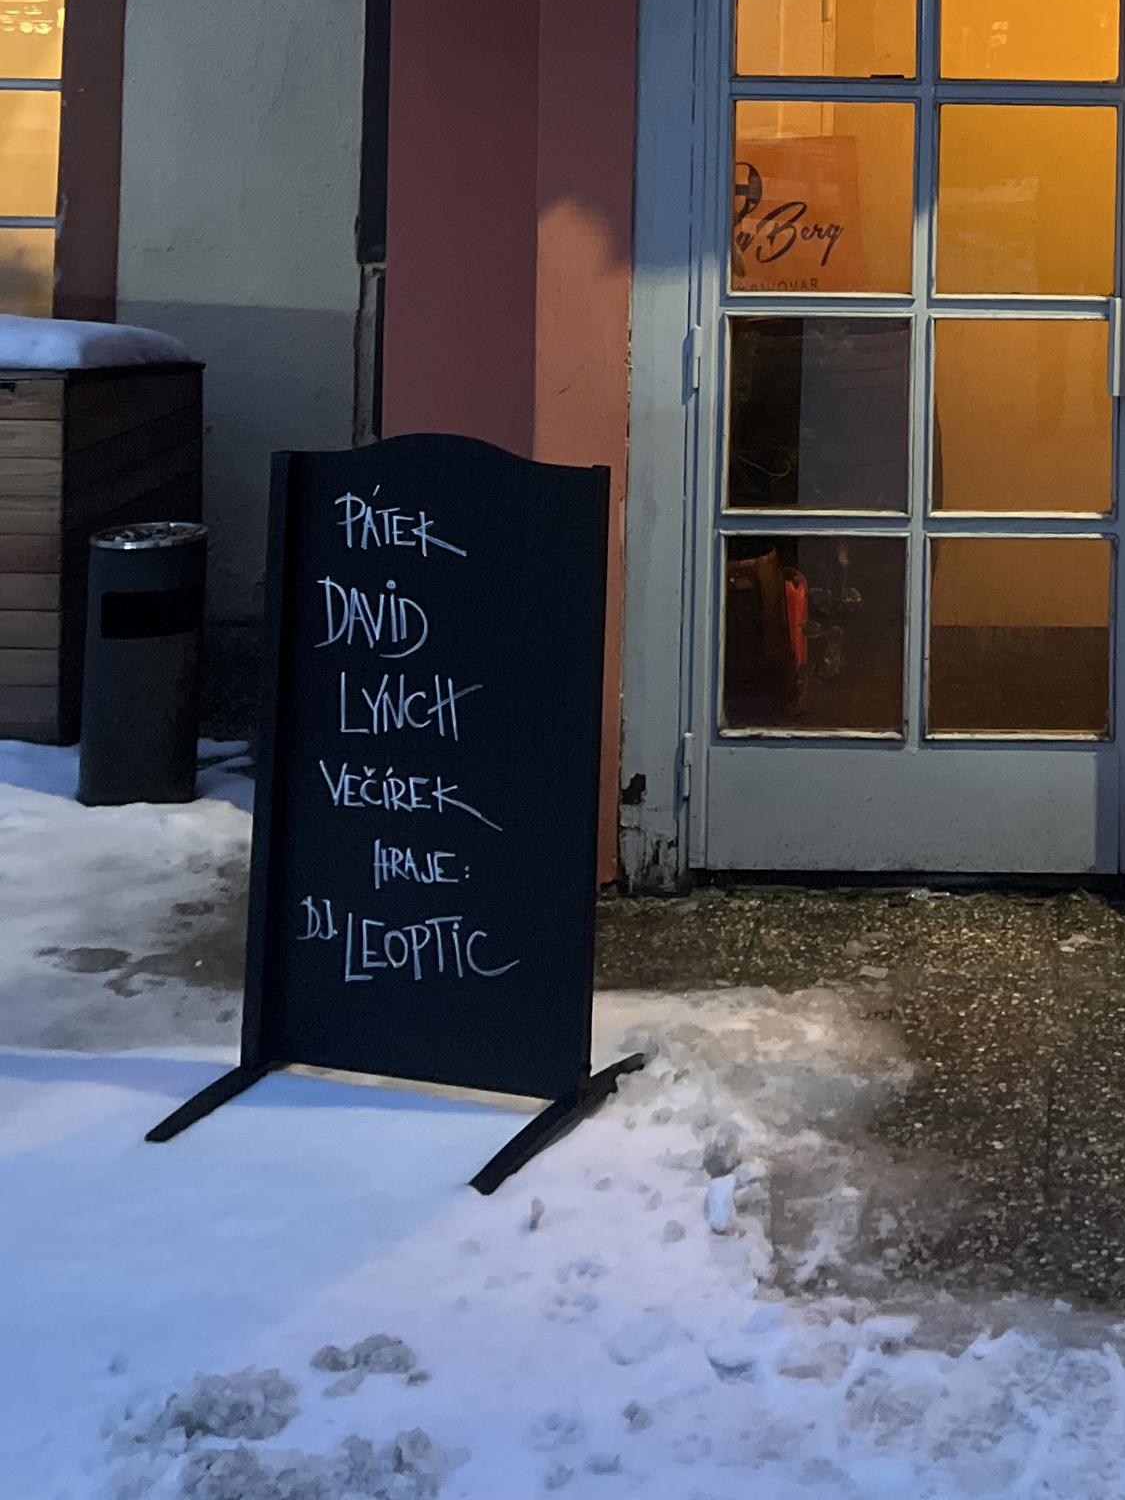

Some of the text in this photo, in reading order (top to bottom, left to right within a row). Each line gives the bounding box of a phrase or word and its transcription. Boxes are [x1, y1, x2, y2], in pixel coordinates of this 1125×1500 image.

[334, 484, 468, 557] PÁTEK
[314, 575, 429, 659] DAVID
[340, 671, 484, 741] LYNCH
[319, 759, 503, 832] VEČÍREK
[344, 912, 520, 983] LEOPTIC
